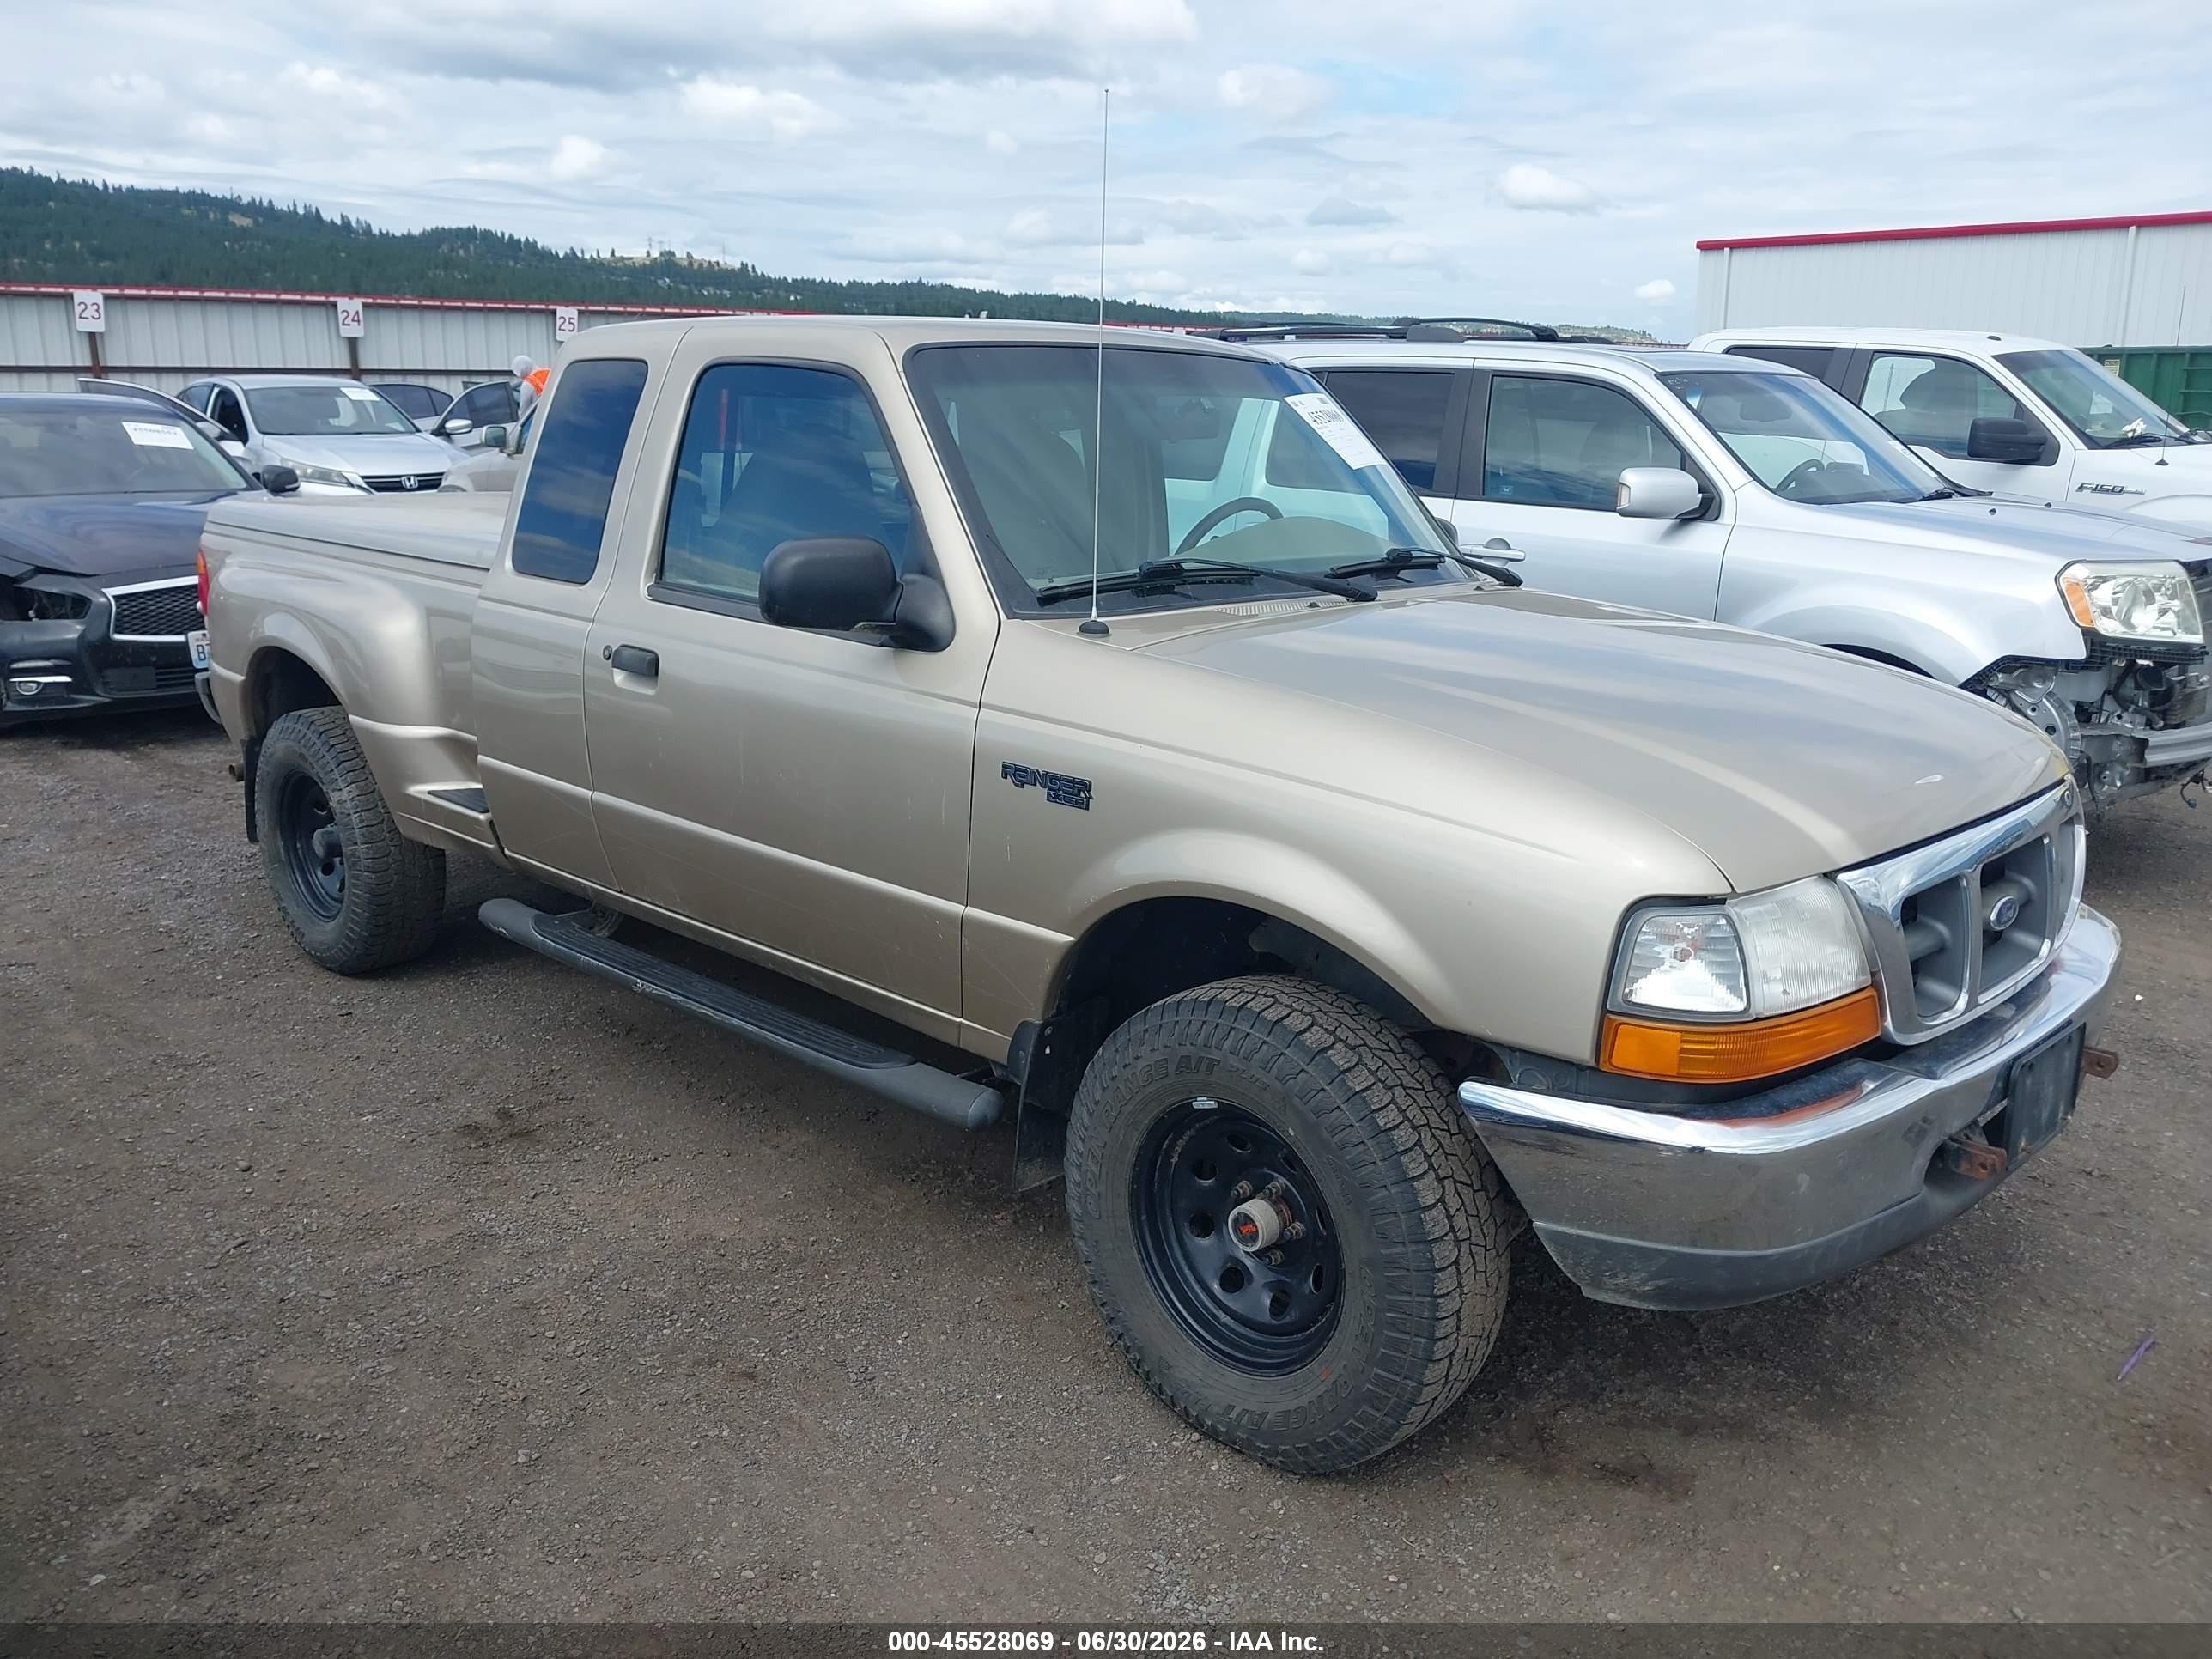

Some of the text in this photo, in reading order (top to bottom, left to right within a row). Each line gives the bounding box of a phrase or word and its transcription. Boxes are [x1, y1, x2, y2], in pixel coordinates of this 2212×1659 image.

[77, 301, 101, 320] 23
[340, 309, 362, 326] 24
[558, 316, 576, 332] 25
[1001, 761, 1094, 799] RANGER
[1102, 1057, 1169, 1133] RANGE
[1175, 1054, 1221, 1074] A/T
